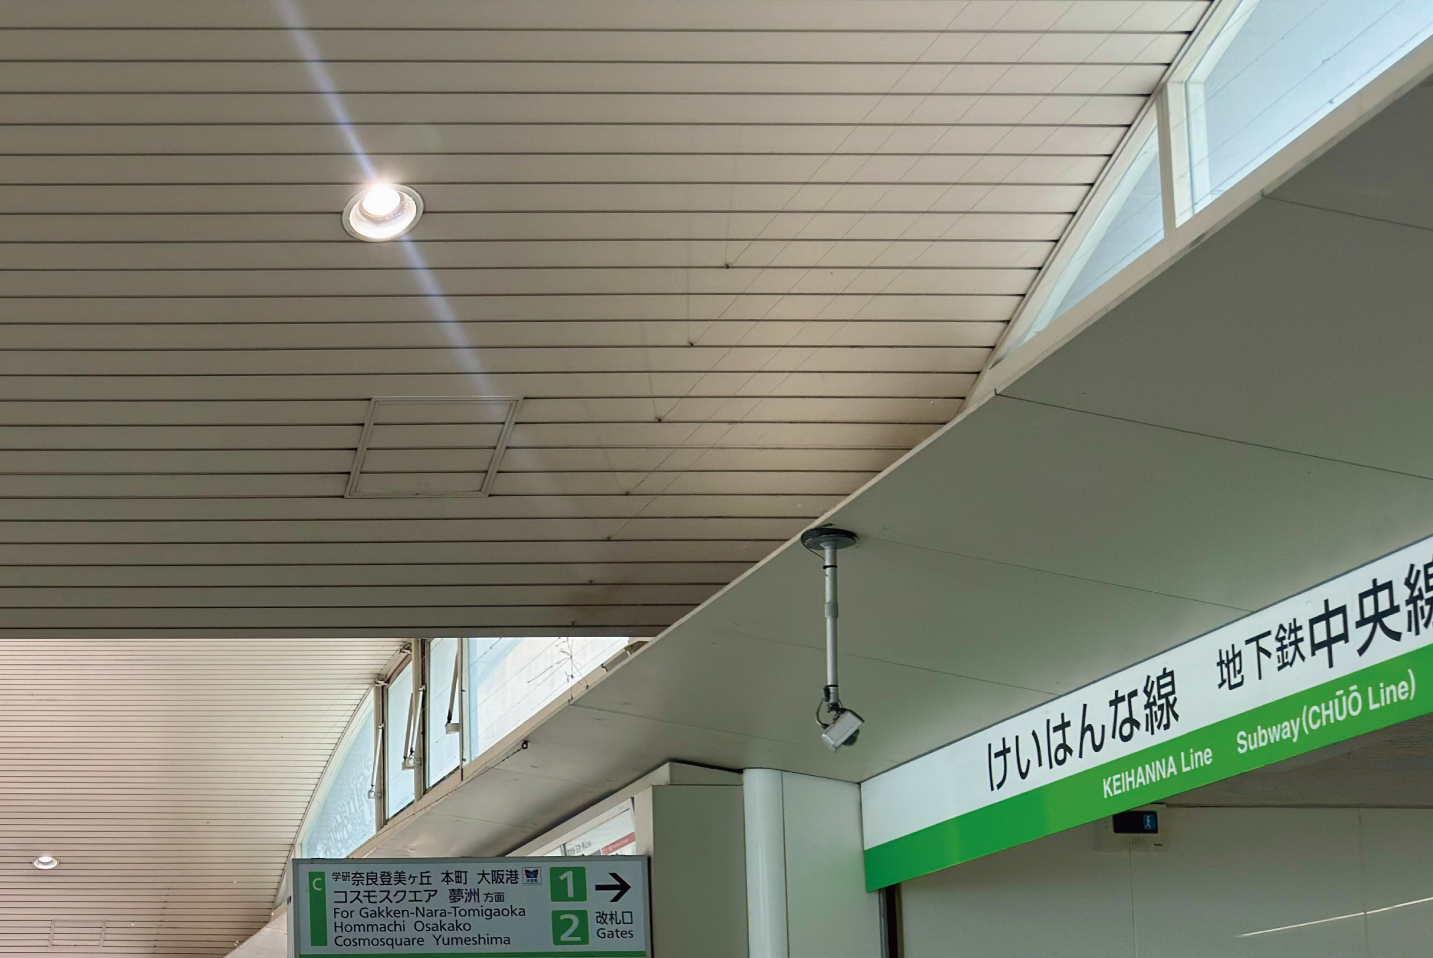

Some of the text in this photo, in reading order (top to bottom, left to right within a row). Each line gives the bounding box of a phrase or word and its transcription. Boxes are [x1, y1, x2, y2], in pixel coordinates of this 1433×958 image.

[986, 667, 1180, 792] けいはんな線
[1102, 757, 1178, 799] KEIHANNA
[1180, 745, 1214, 774] Line
[1368, 668, 1416, 711] Line)
[312, 877, 323, 891] C
[440, 869, 468, 886] 本町
[477, 868, 520, 886] 大阪港
[558, 870, 574, 898] 1
[333, 888, 505, 904] コスモスクエア 夢洲 方面
[333, 905, 526, 921] For Gakken-Nara-Tomigaoka
[595, 911, 633, 926] 改札口
[334, 920, 472, 933] Hommachi Osakako
[559, 913, 582, 942] 2
[596, 928, 634, 940] Gates
[334, 933, 511, 948] Cosmosquare Yumeshima
